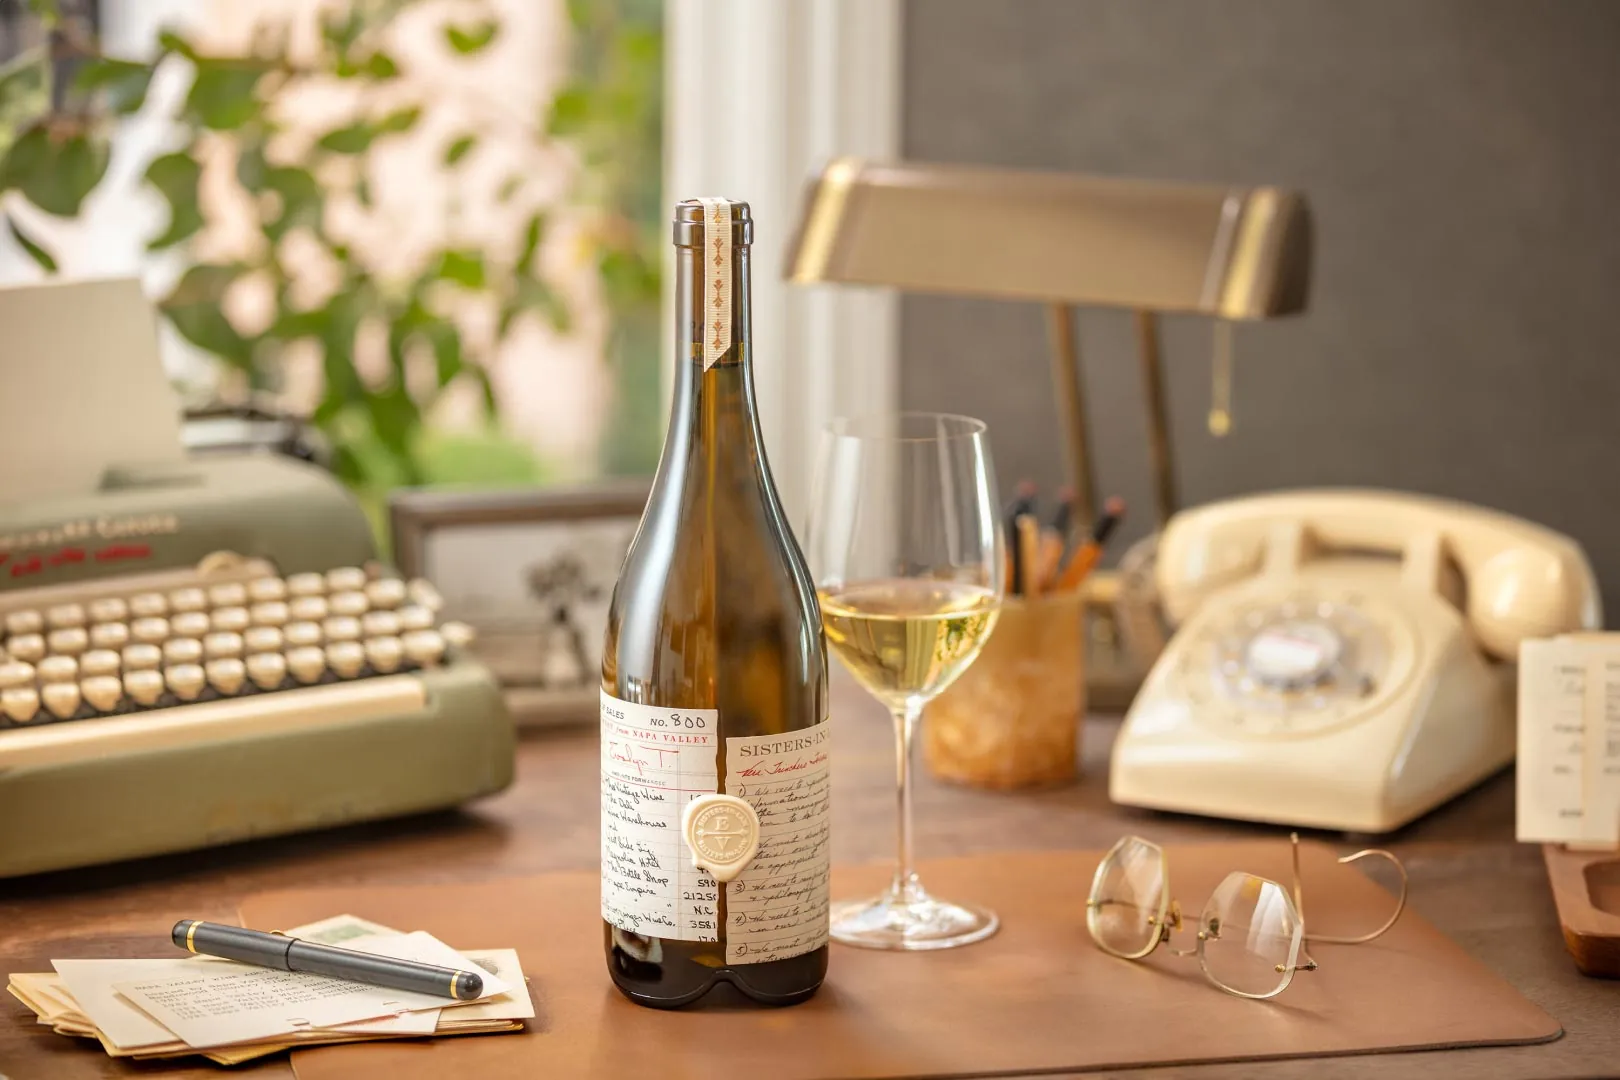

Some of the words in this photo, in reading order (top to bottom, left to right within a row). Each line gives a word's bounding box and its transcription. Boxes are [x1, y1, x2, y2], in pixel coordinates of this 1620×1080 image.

[606, 706, 625, 720] SALES
[650, 718, 669, 727] NO.
[670, 713, 706, 728] 800
[632, 730, 657, 740] NAPA
[663, 734, 709, 744] VALLEY
[639, 787, 665, 801] Wine
[714, 816, 730, 831] E
[712, 836, 732, 852] V
[697, 879, 716, 887] 590
